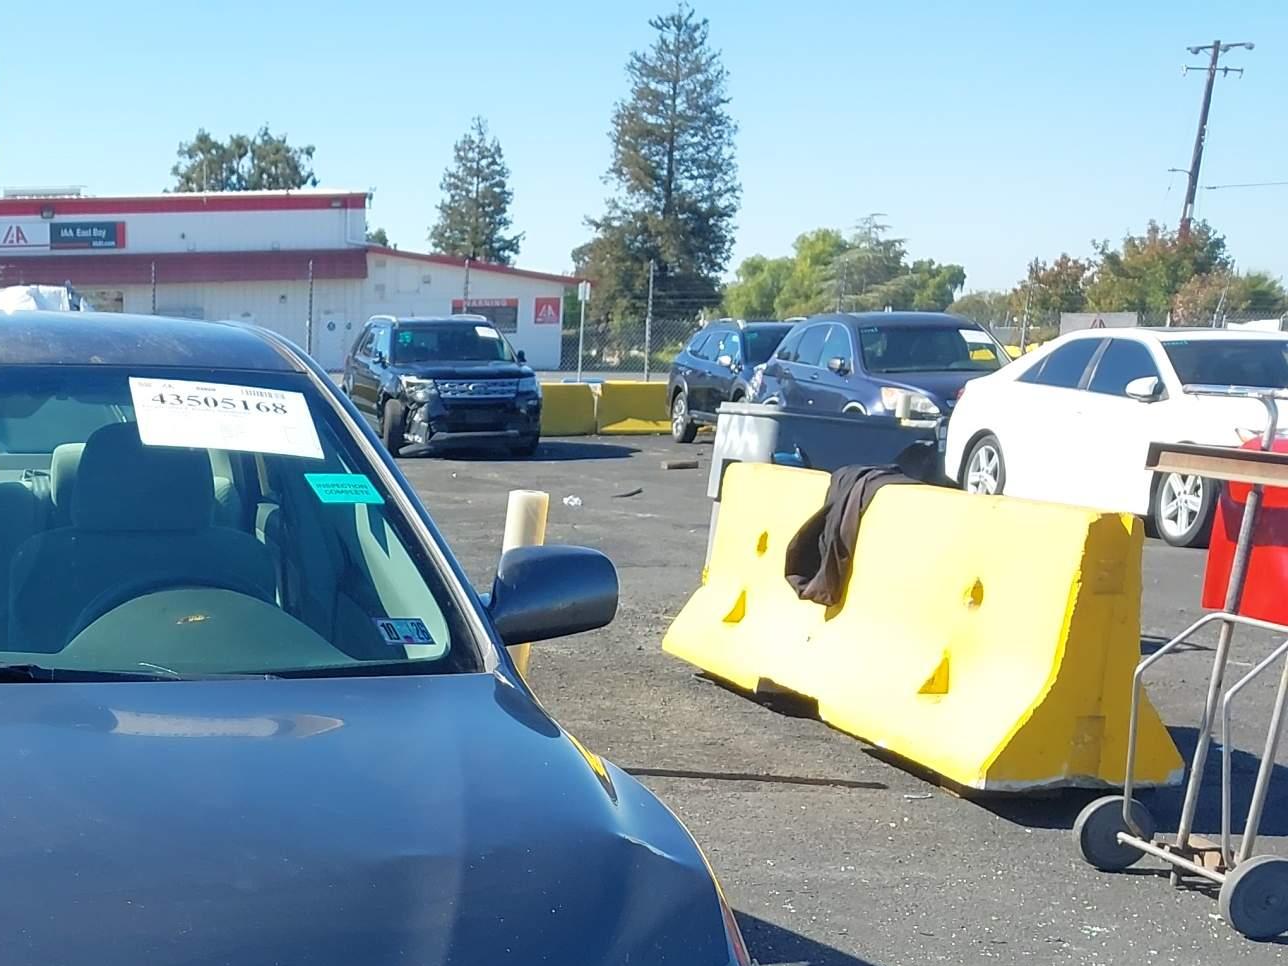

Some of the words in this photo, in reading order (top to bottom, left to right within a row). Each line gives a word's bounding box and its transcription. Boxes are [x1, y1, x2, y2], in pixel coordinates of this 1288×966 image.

[76, 228, 92, 237] East
[93, 228, 107, 238] Bay
[151, 393, 288, 415] 43505168
[379, 622, 401, 641] 10
